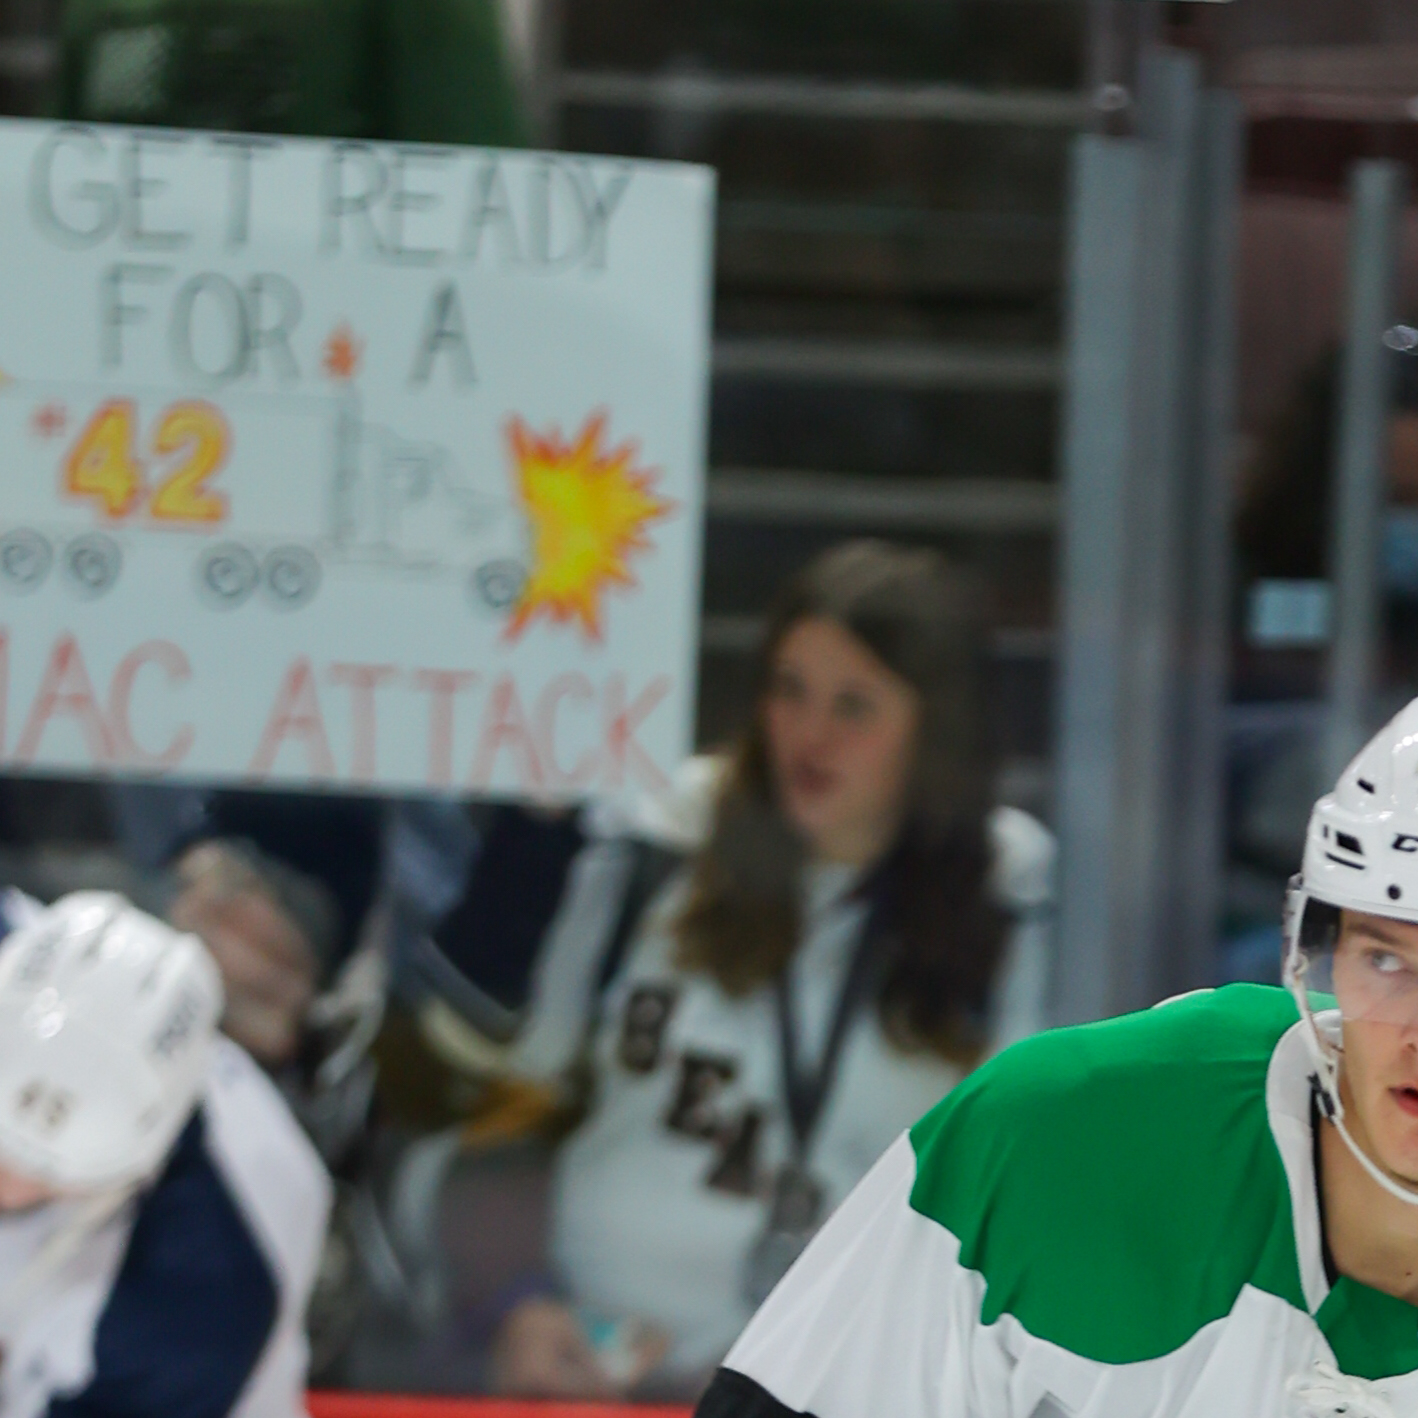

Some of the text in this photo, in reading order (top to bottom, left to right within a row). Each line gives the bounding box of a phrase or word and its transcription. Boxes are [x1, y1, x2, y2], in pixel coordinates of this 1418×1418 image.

[27, 125, 635, 275] GET READY
[100, 262, 478, 388] FOR A
[0, 625, 678, 795] AC ATTACK
